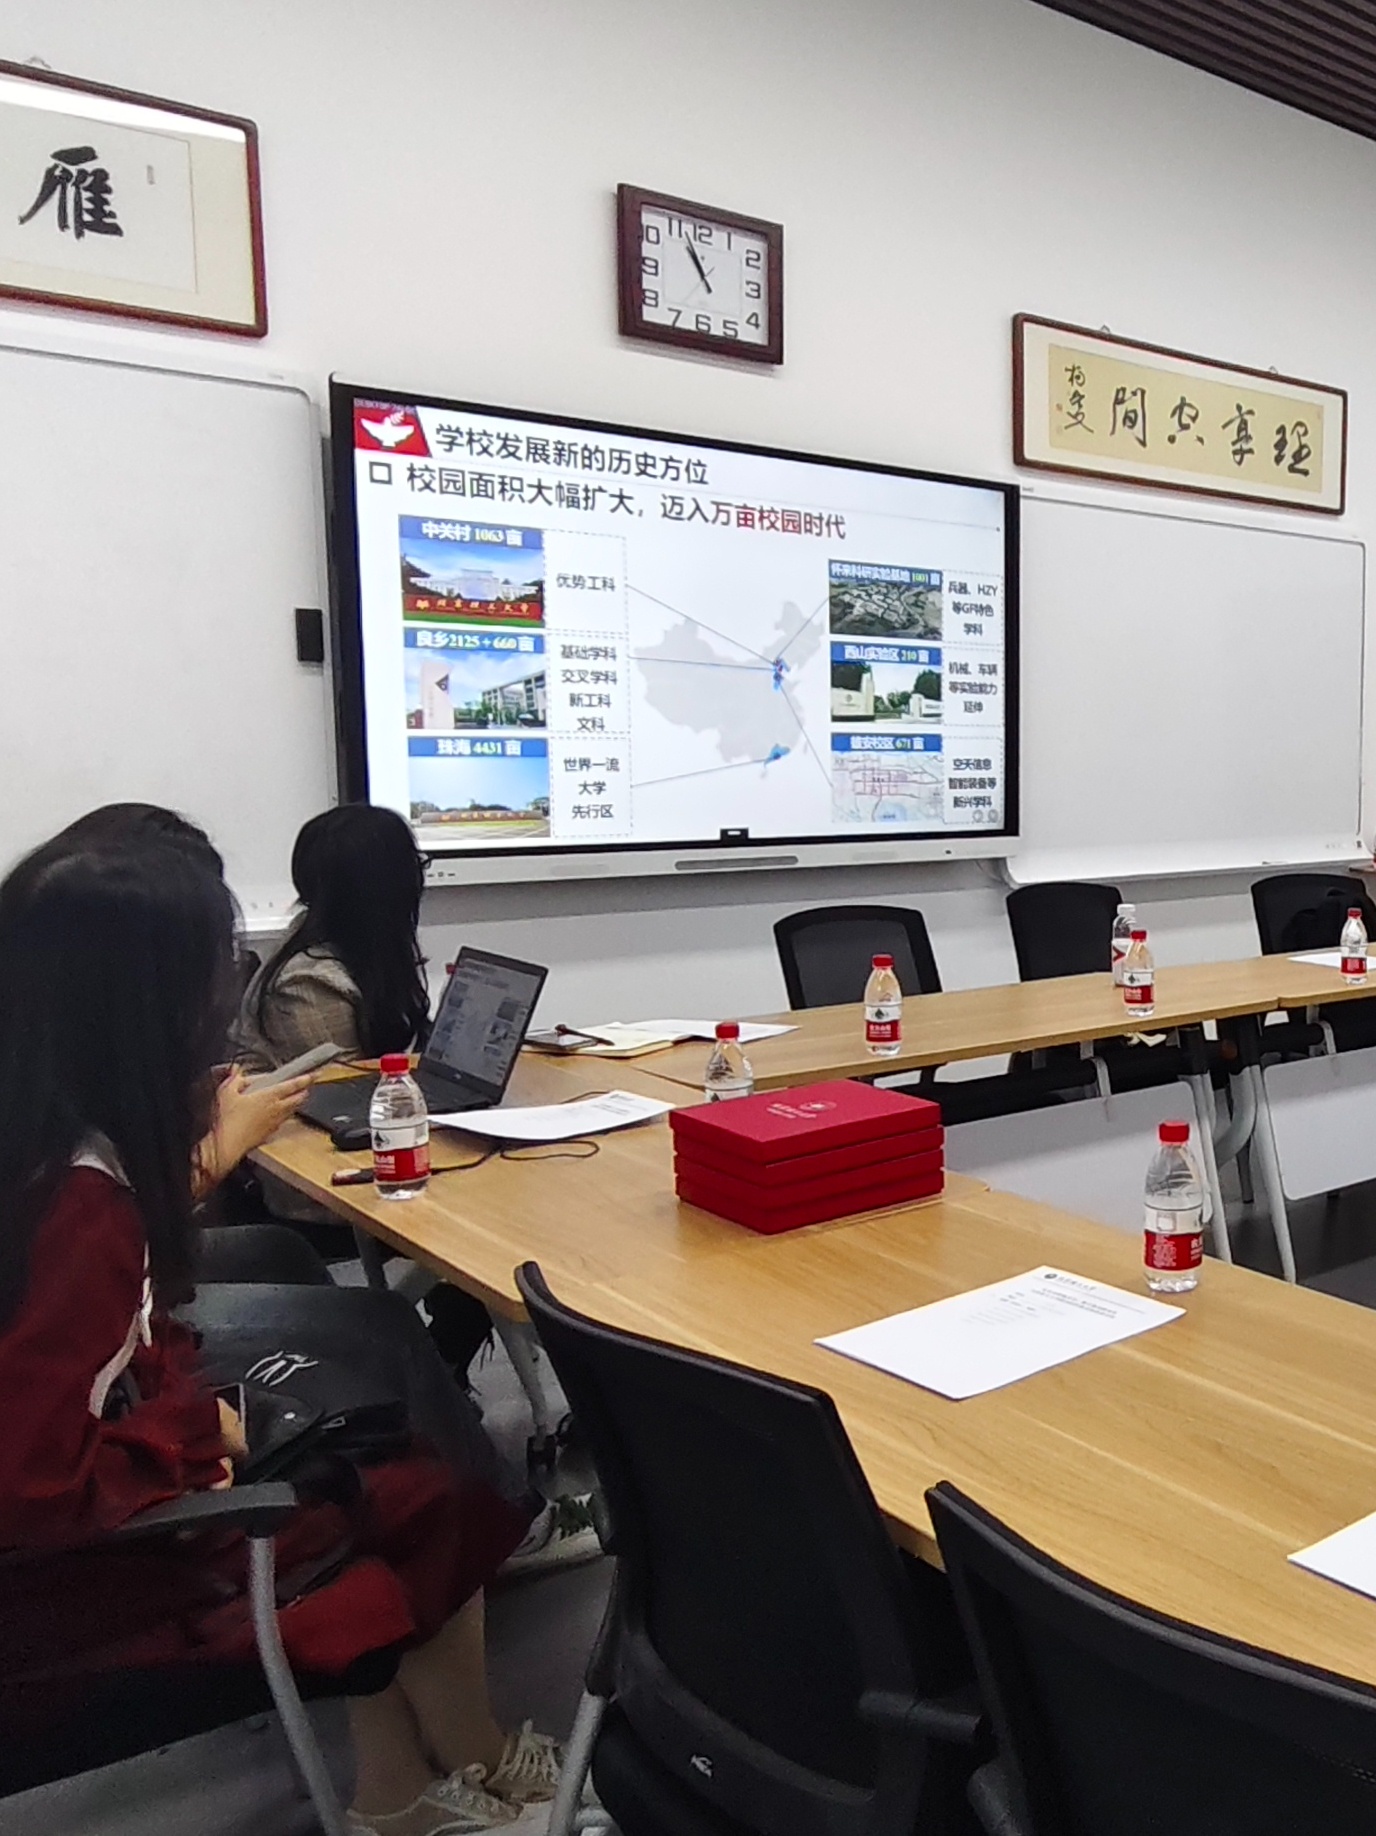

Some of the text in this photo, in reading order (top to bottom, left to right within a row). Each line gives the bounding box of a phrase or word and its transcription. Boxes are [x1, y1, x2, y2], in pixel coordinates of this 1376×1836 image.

[18, 145, 124, 239] 雁
[668, 217, 682, 238] 11
[693, 223, 713, 245] 12
[642, 256, 659, 277] 9
[746, 249, 761, 270] 2
[642, 289, 659, 308] 8
[745, 281, 761, 299] 3
[668, 307, 682, 329] 7
[695, 314, 711, 333] 6
[745, 312, 760, 330] 4
[723, 320, 738, 339] 5
[436, 424, 709, 485] 学校发展新的历史方位
[407, 463, 847, 539] 校园面积大幅扩大，迈入万亩校园时代
[422, 521, 471, 542] 中关村
[556, 573, 616, 592] 优势工科
[964, 623, 983, 636] 学科
[561, 644, 617, 661] 基础学科
[561, 669, 617, 685] 交叉学科
[569, 693, 611, 708] 新工科
[577, 717, 605, 732] 文科
[437, 739, 471, 755] 珠海
[564, 758, 620, 772] 世界一流
[578, 781, 606, 795] 大学
[572, 804, 614, 819] 先行区
